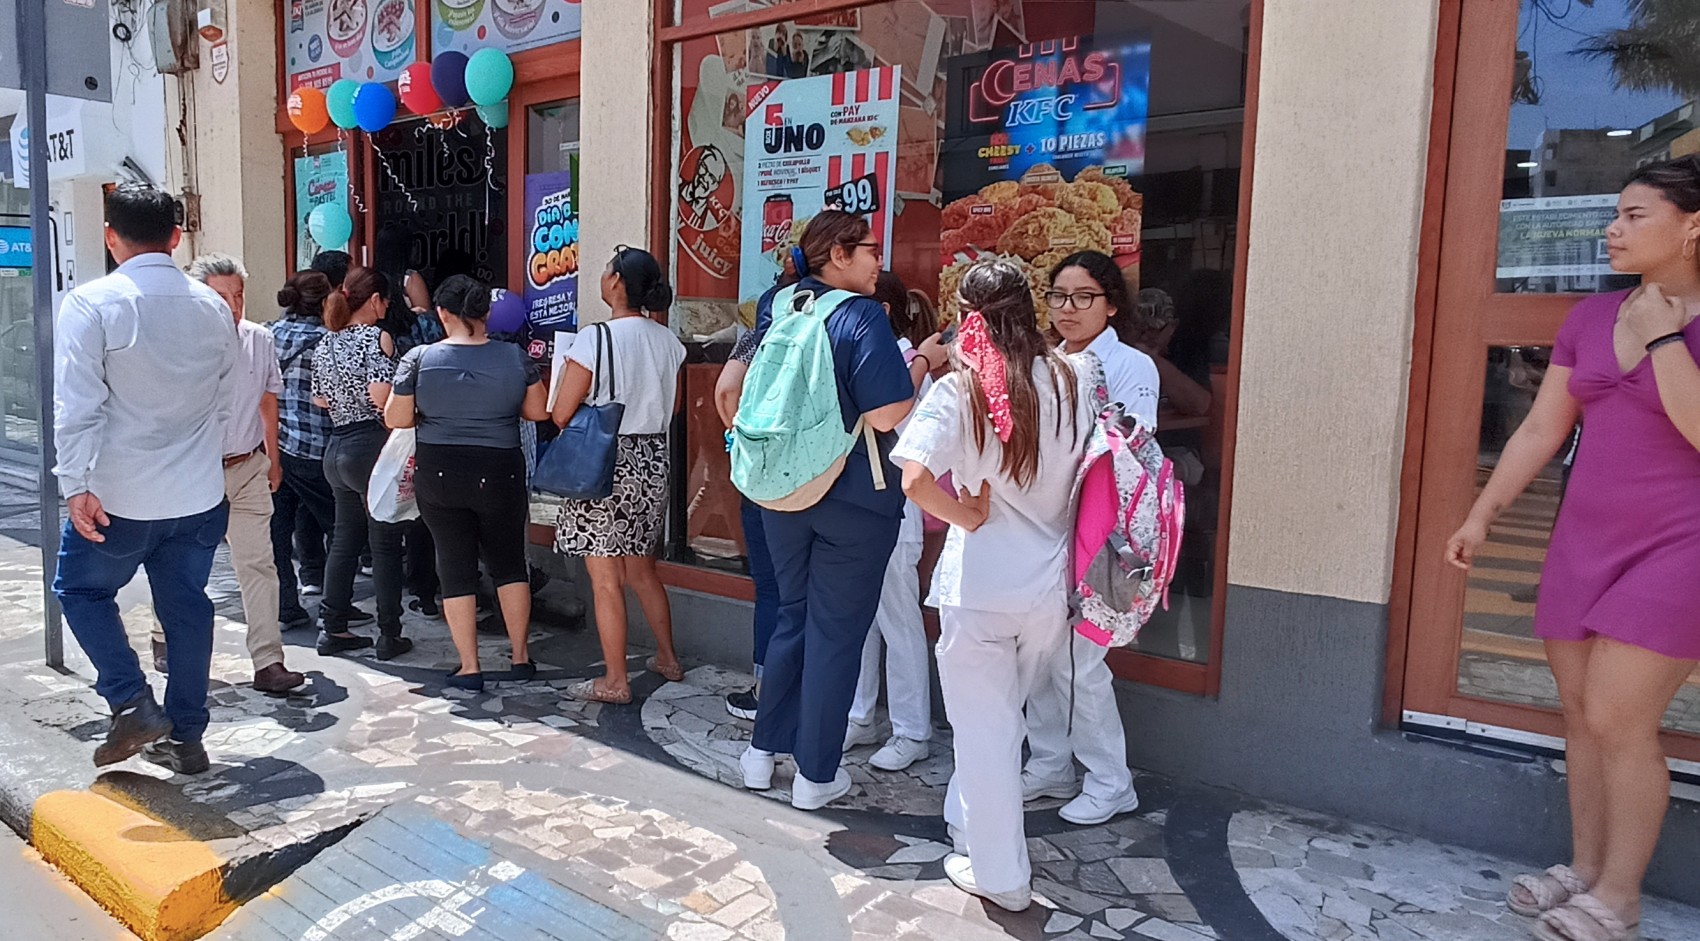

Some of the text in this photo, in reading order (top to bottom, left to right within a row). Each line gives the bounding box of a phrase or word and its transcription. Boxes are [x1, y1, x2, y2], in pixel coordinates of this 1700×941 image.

[981, 52, 1105, 104] CENAS
[748, 85, 770, 111] NUEVO
[765, 103, 783, 126] 5
[842, 105, 860, 117] PAY
[1005, 93, 1076, 127] KFC
[47, 129, 74, 162] T&T
[764, 123, 825, 154] UNO
[1040, 133, 1104, 152] 10 PIEZAS
[709, 195, 728, 217] KFC
[1566, 229, 1606, 238] NORMAL
[1585, 219, 1612, 227] SANITA
[535, 218, 579, 253] CON
[11, 242, 32, 253] AT&
[691, 233, 733, 275] juicy
[567, 291, 573, 300] Y
[531, 344, 543, 353] DQ
